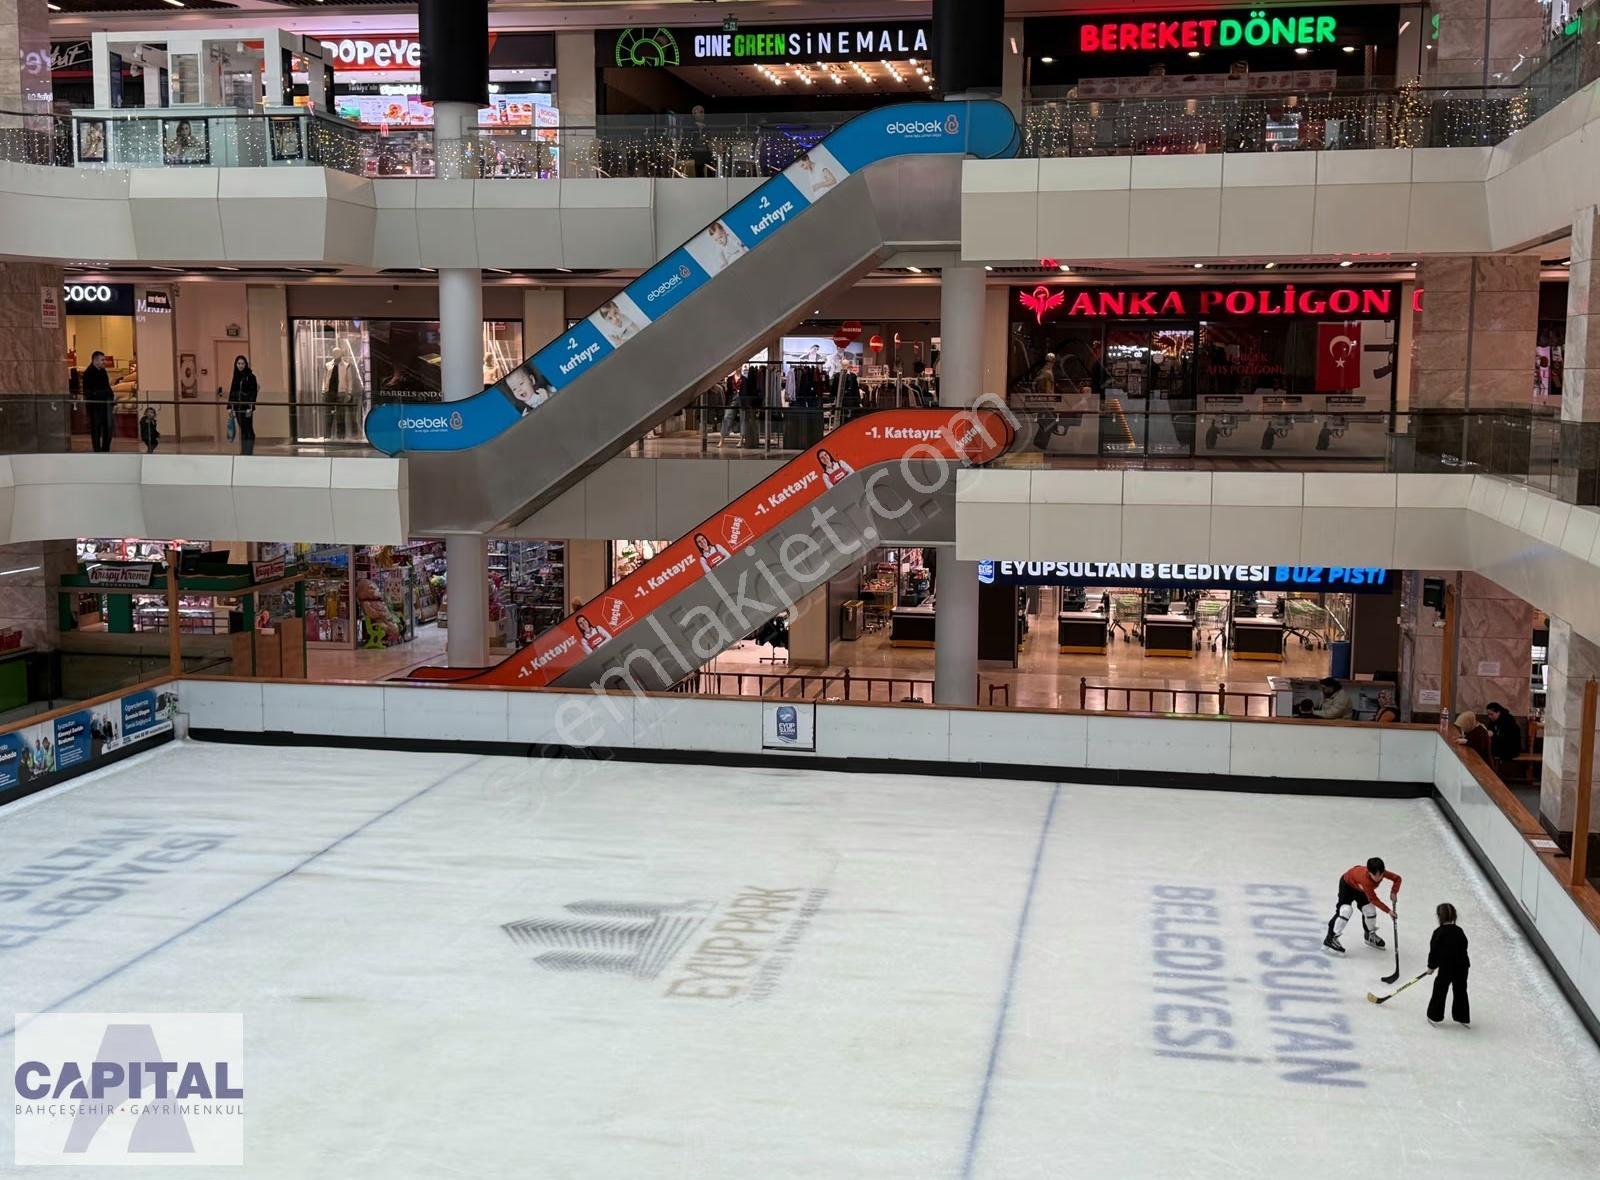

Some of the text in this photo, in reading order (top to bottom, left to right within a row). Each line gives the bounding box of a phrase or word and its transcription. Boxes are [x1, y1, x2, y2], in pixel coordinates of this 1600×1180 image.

[1080, 11, 1337, 52] BEREKET DÖNER
[694, 34, 731, 57] CINE
[734, 34, 786, 57] GREEN
[886, 120, 942, 134] ebebek
[758, 195, 771, 210] -2
[750, 200, 794, 236] kattayız
[647, 273, 681, 302] ebebek
[1068, 284, 1391, 316] ANKA POLİGON
[567, 337, 578, 351] -2
[559, 342, 600, 375] kattayız
[380, 390, 417, 398] BARRELS
[418, 390, 437, 398] AND
[398, 416, 448, 429] ebebek
[865, 426, 942, 440] -1. Kattayız
[754, 470, 819, 517] -1. Kattayız
[91, 567, 150, 581] Krispy Kreme
[634, 553, 696, 600] -1. Kattayız
[1275, 566, 1322, 583] BUZ
[518, 635, 578, 680] -1. Kattayız
[1152, 884, 1263, 1064] BELEDİYESİ
